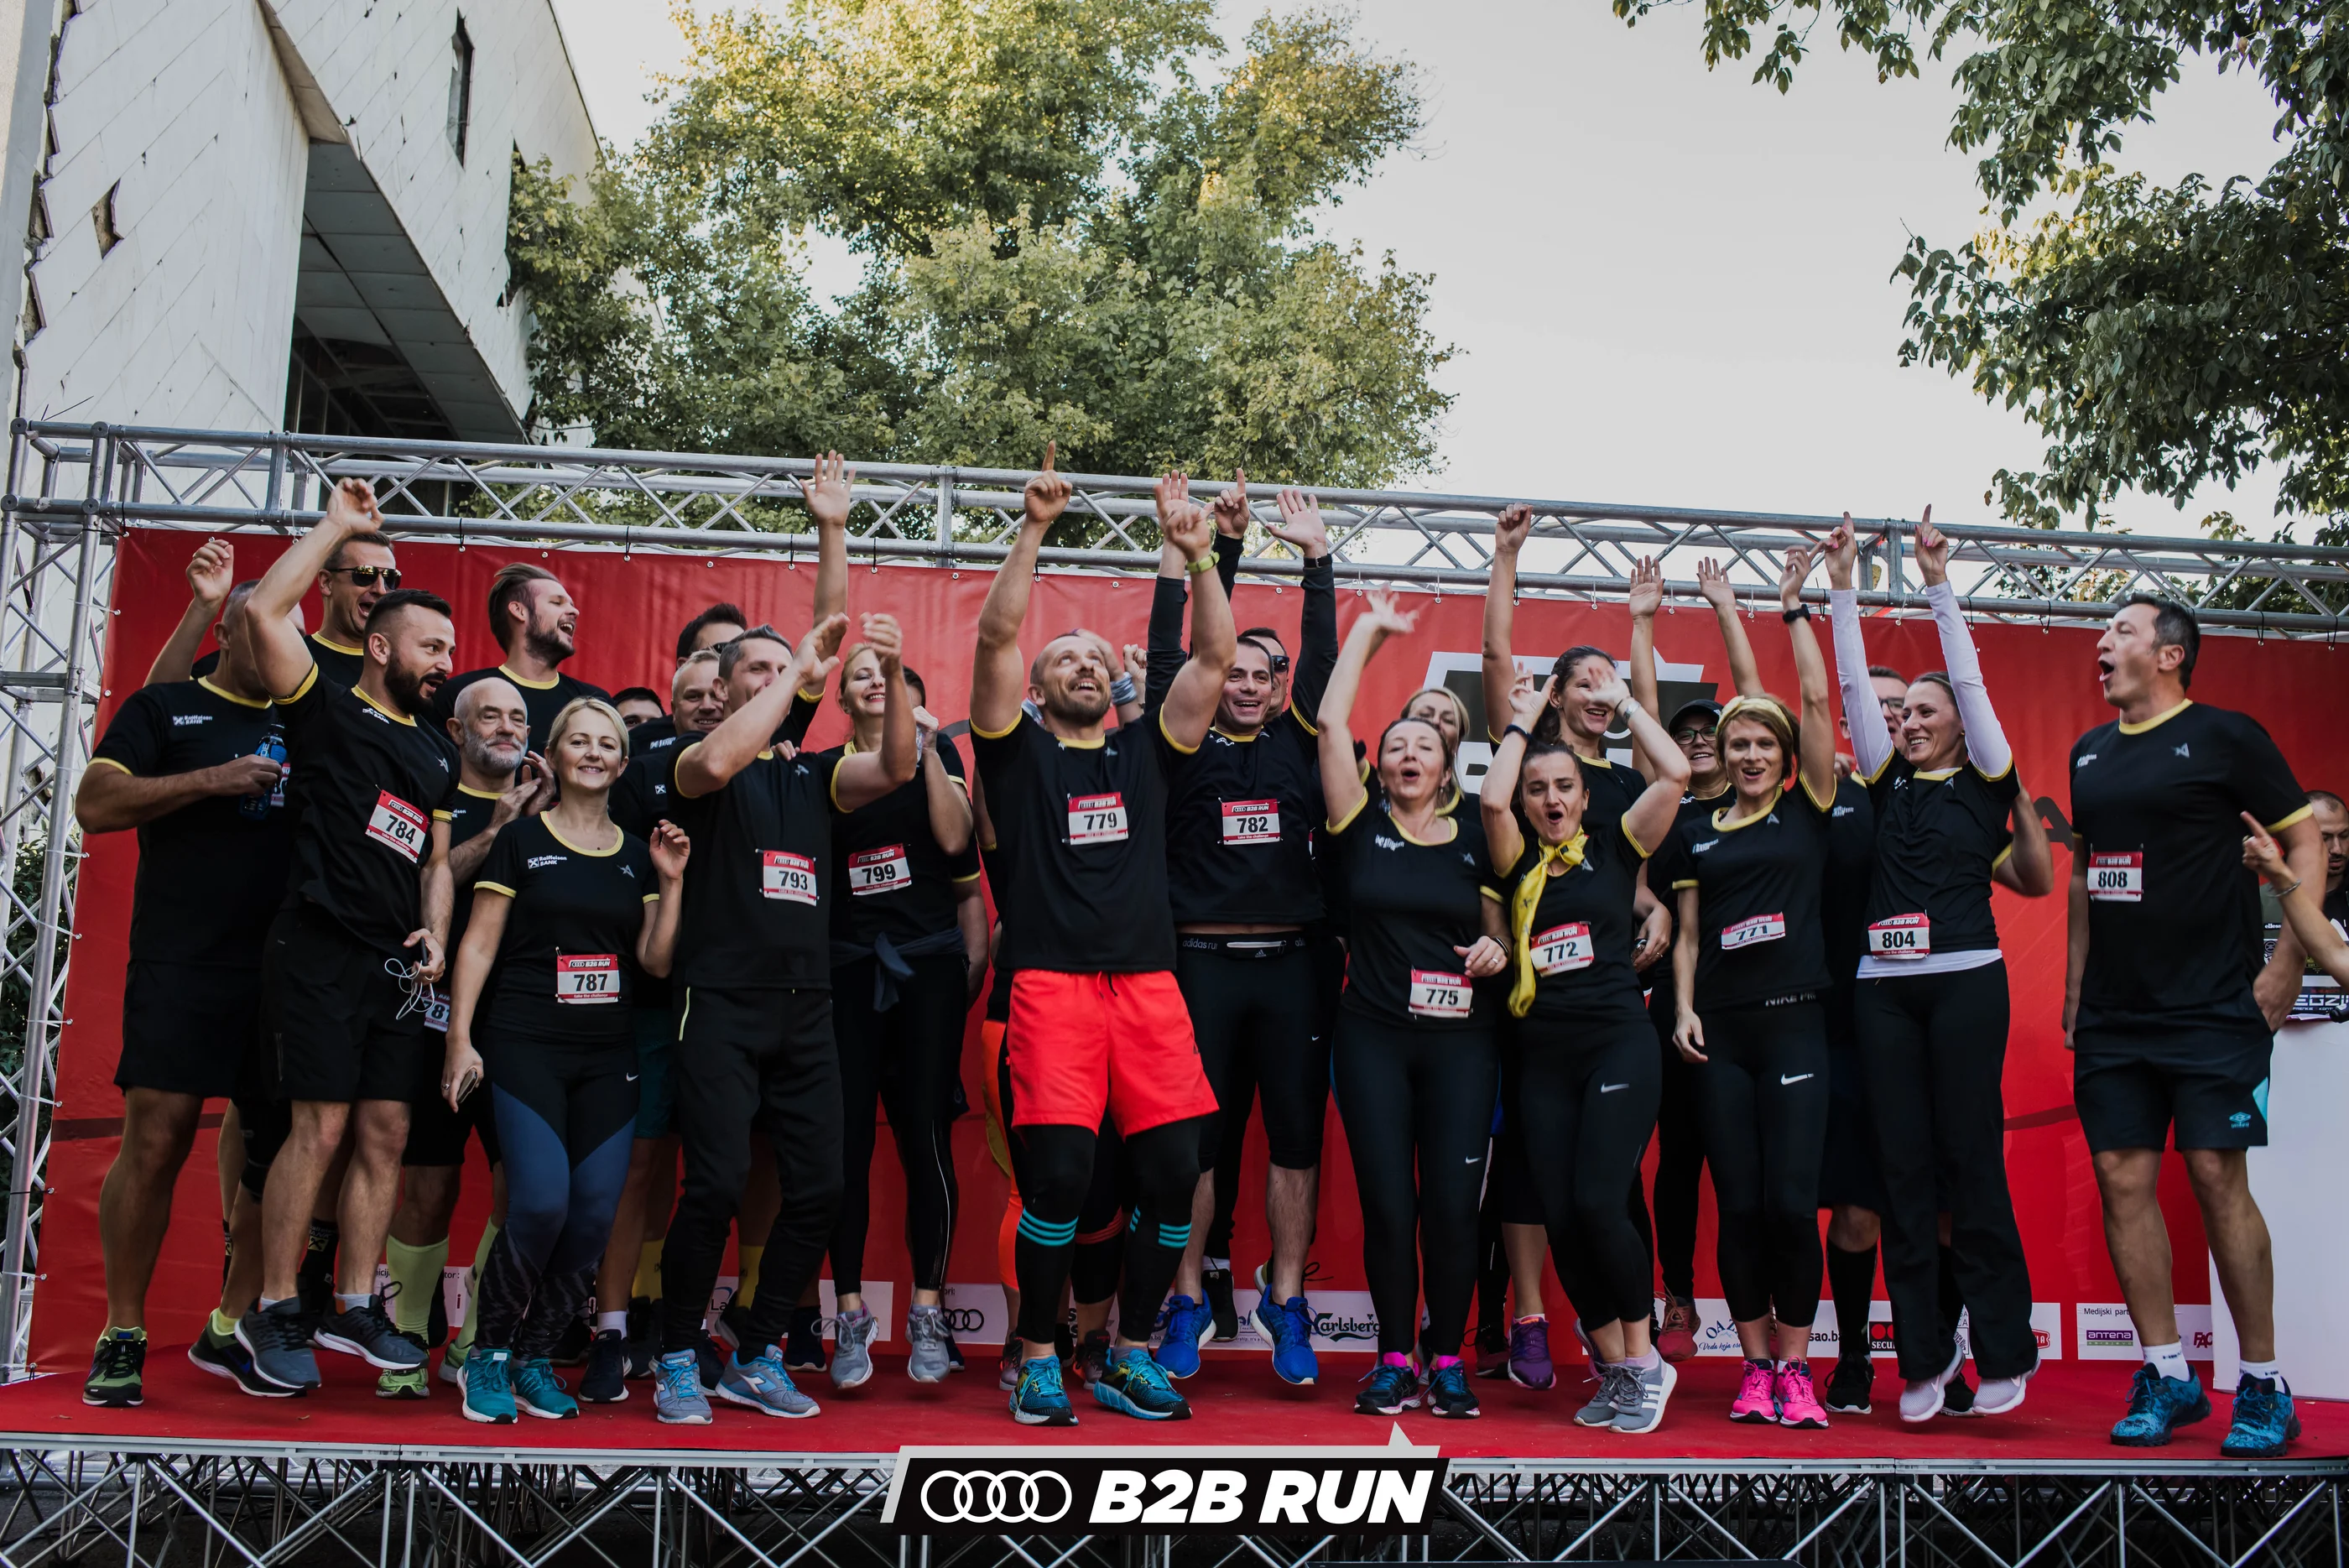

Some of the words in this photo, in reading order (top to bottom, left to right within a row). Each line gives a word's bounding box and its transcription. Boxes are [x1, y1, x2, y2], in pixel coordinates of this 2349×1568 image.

[386, 814, 416, 845] 784
[1084, 812, 1117, 831] 779
[1237, 816, 1268, 834] 782
[779, 870, 808, 891] 793
[862, 863, 896, 884] 799
[2098, 871, 2128, 888] 808
[1736, 925, 1768, 941] 771
[1883, 930, 1916, 949] 804
[1183, 938, 1207, 950] adidas
[1544, 941, 1579, 963] 772
[574, 973, 608, 992] 787
[1426, 987, 1459, 1006] 775
[2084, 1307, 2112, 1318] Medijski
